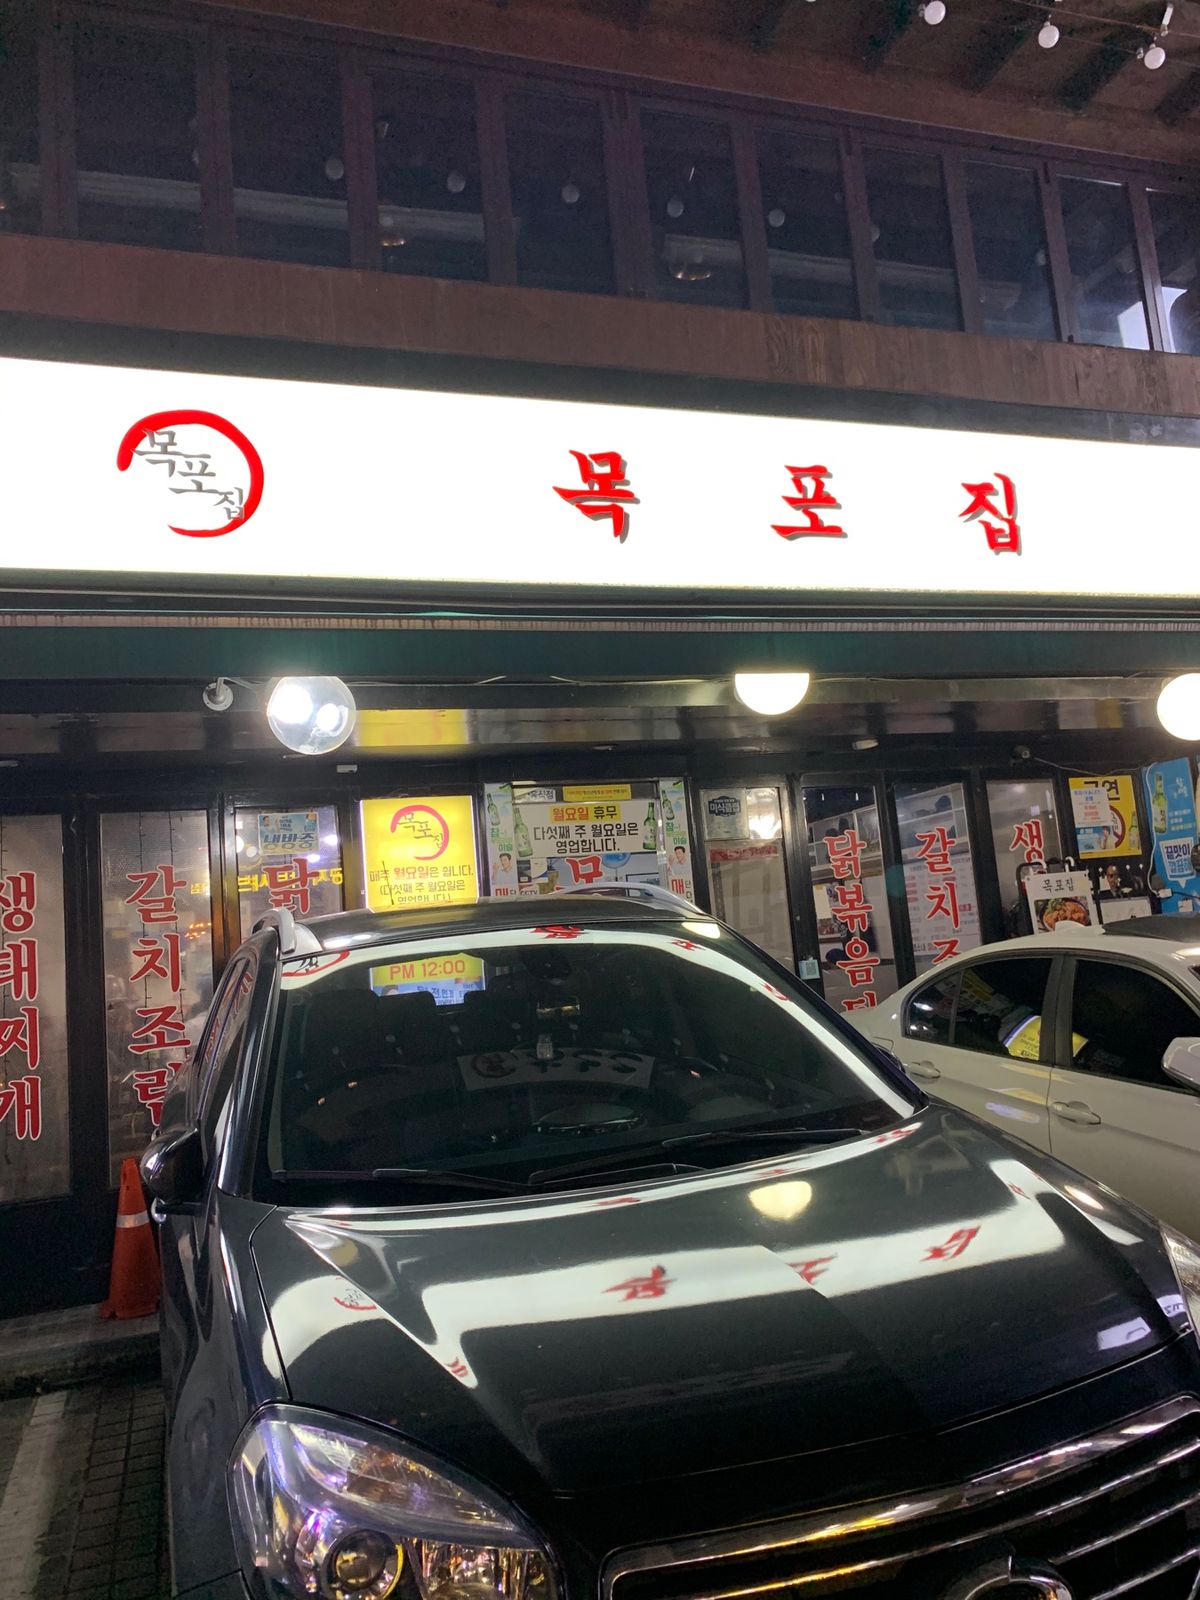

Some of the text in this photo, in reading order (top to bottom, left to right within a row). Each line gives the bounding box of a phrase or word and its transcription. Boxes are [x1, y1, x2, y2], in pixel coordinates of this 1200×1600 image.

[131, 428, 245, 520] 목포집
[552, 804, 618, 822] 월요일 휴무
[397, 812, 444, 849] 목포집
[533, 821, 639, 841] 다섯째 주 월요일은
[262, 832, 315, 850] 냉방중
[555, 836, 621, 854] 영업합니다.
[369, 869, 390, 882] 매주
[393, 865, 438, 880] 월요일은
[415, 882, 425, 892] 주
[428, 878, 466, 893] 월요일은
[1042, 878, 1074, 893] 목포집
[389, 959, 466, 981] PM 12:00
